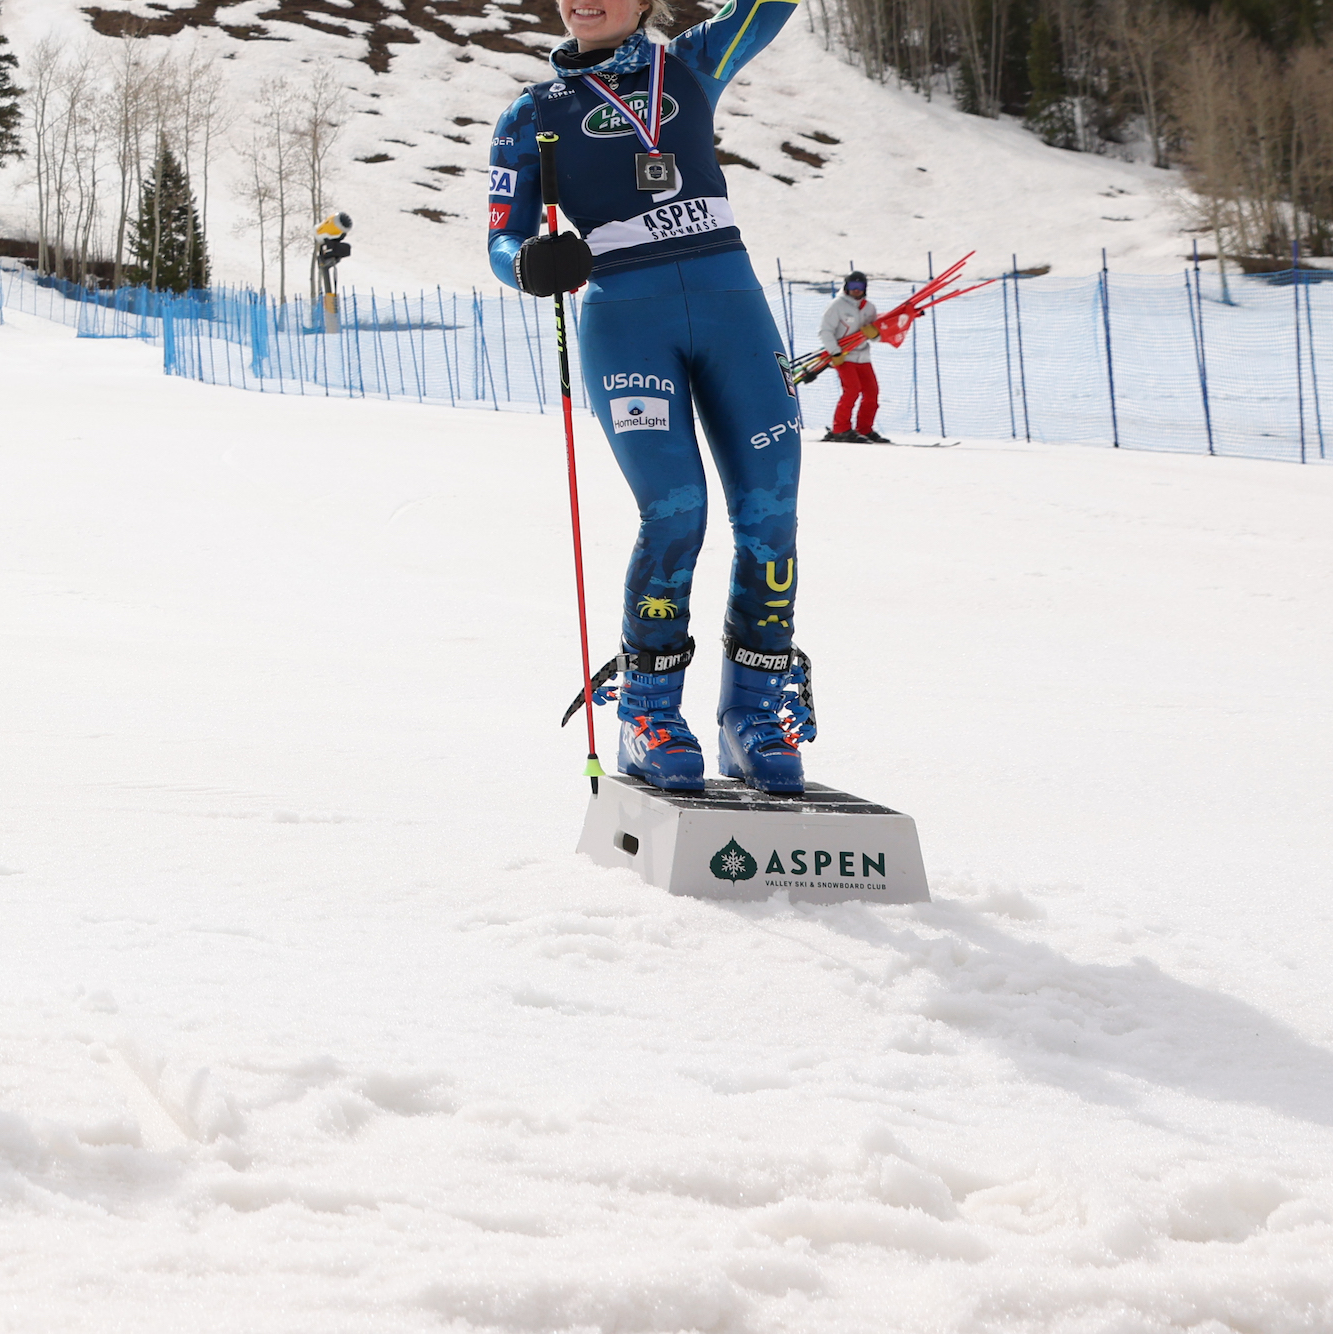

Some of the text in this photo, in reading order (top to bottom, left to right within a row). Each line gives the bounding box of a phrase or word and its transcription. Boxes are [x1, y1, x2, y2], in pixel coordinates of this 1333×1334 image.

[548, 89, 576, 100] ASPEN
[491, 137, 514, 146] DER
[602, 372, 675, 395] USANA
[614, 416, 667, 431] HomeLight
[735, 647, 789, 671] BOOSTER
[765, 849, 886, 878] ASPEN
[817, 881, 865, 890] SNOWBOARD
